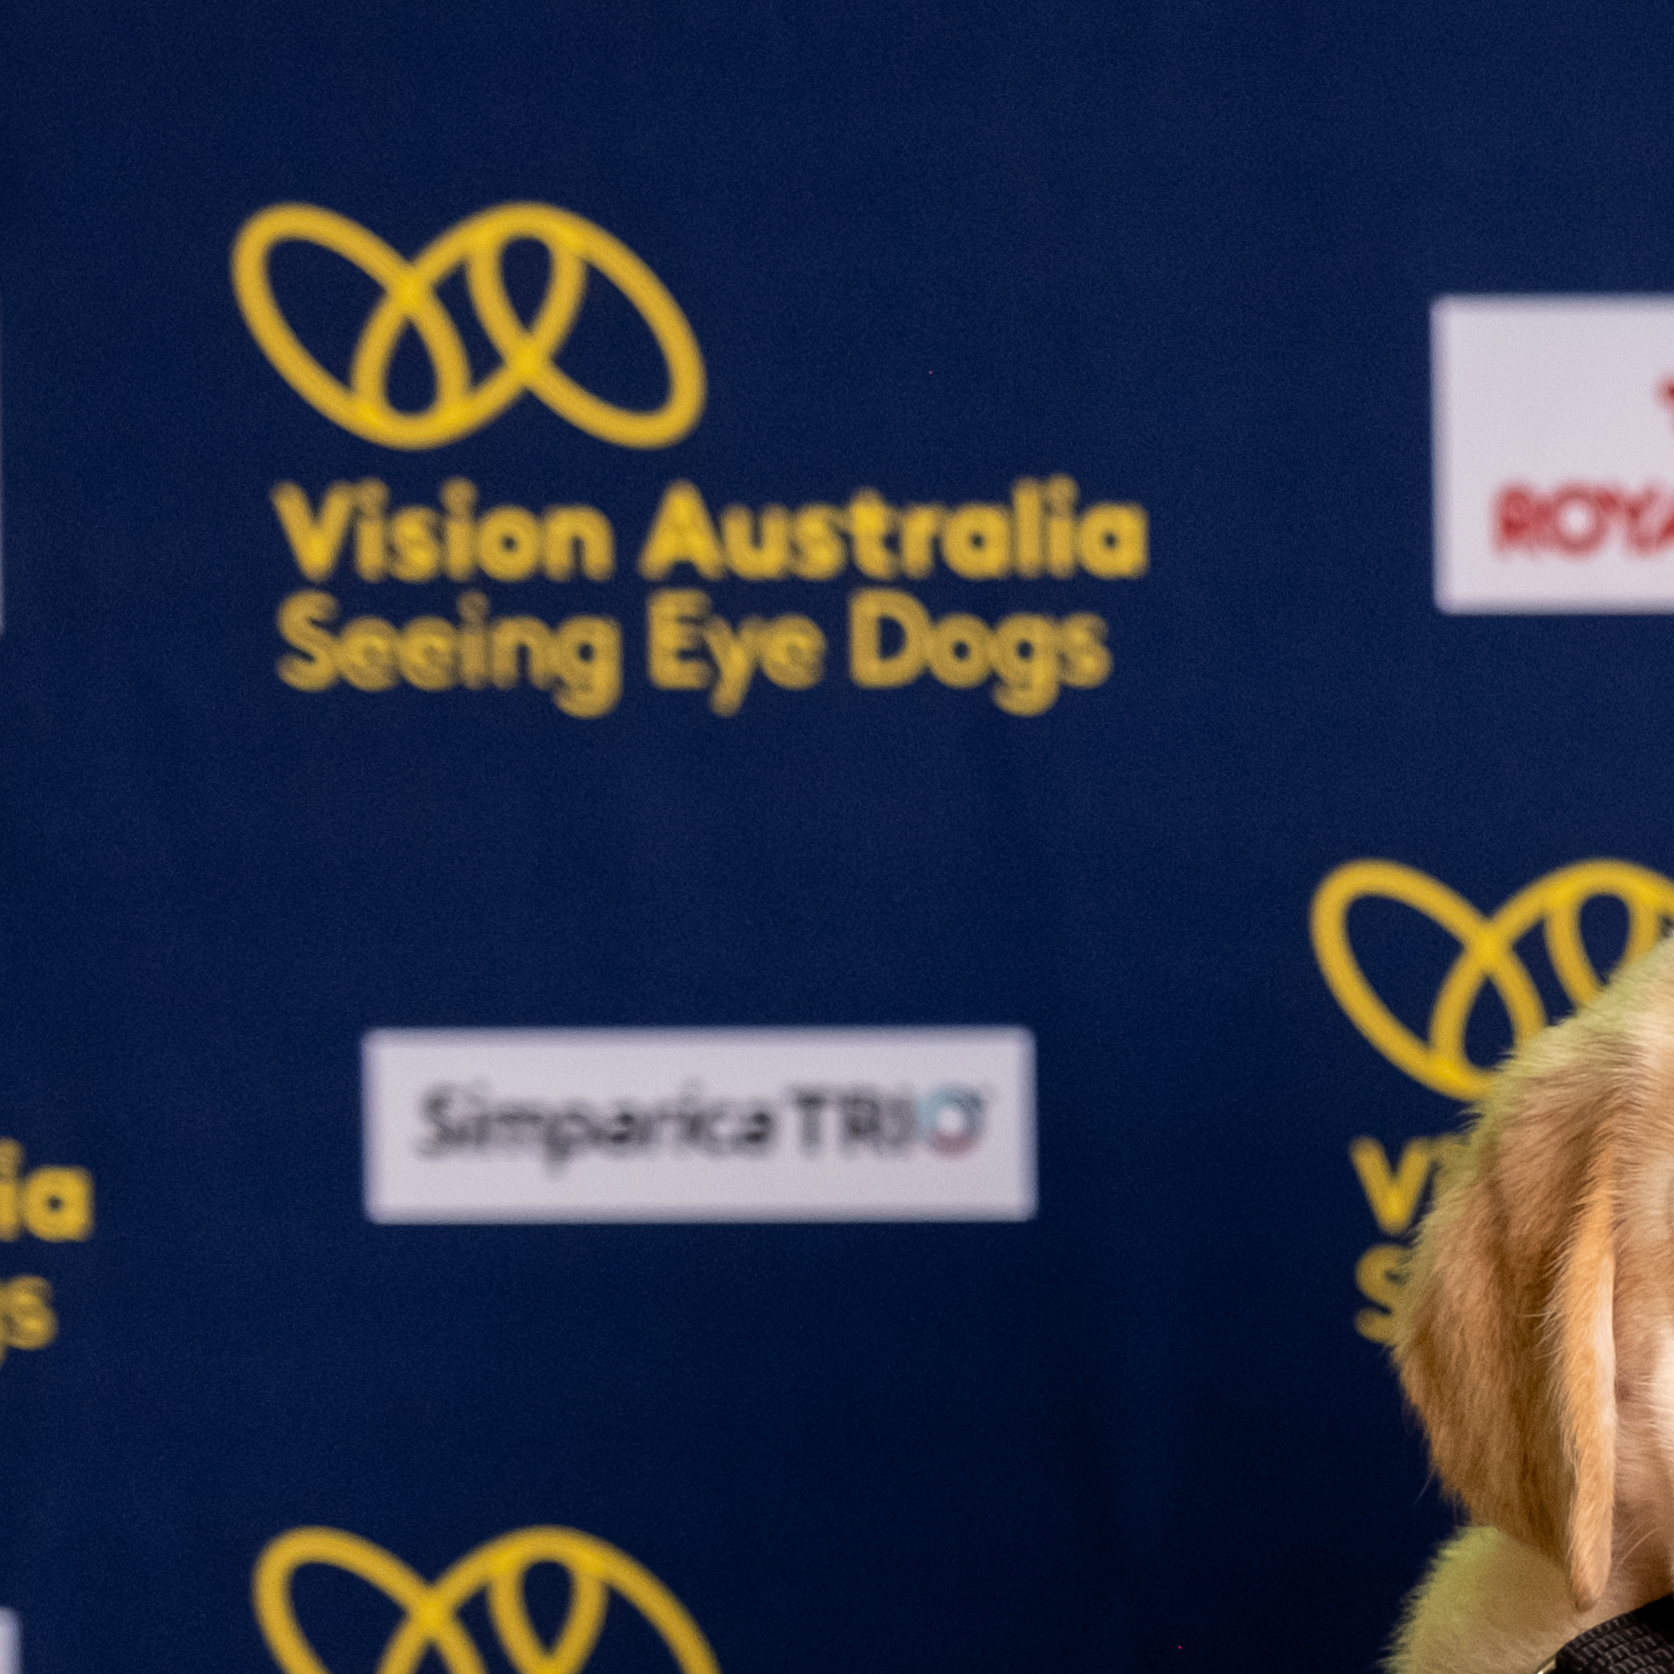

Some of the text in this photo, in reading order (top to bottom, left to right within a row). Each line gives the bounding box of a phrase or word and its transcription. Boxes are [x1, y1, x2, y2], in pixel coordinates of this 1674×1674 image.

[273, 477, 1147, 582] Vision Australia
[278, 585, 1111, 718] Seeing Eye Dogs
